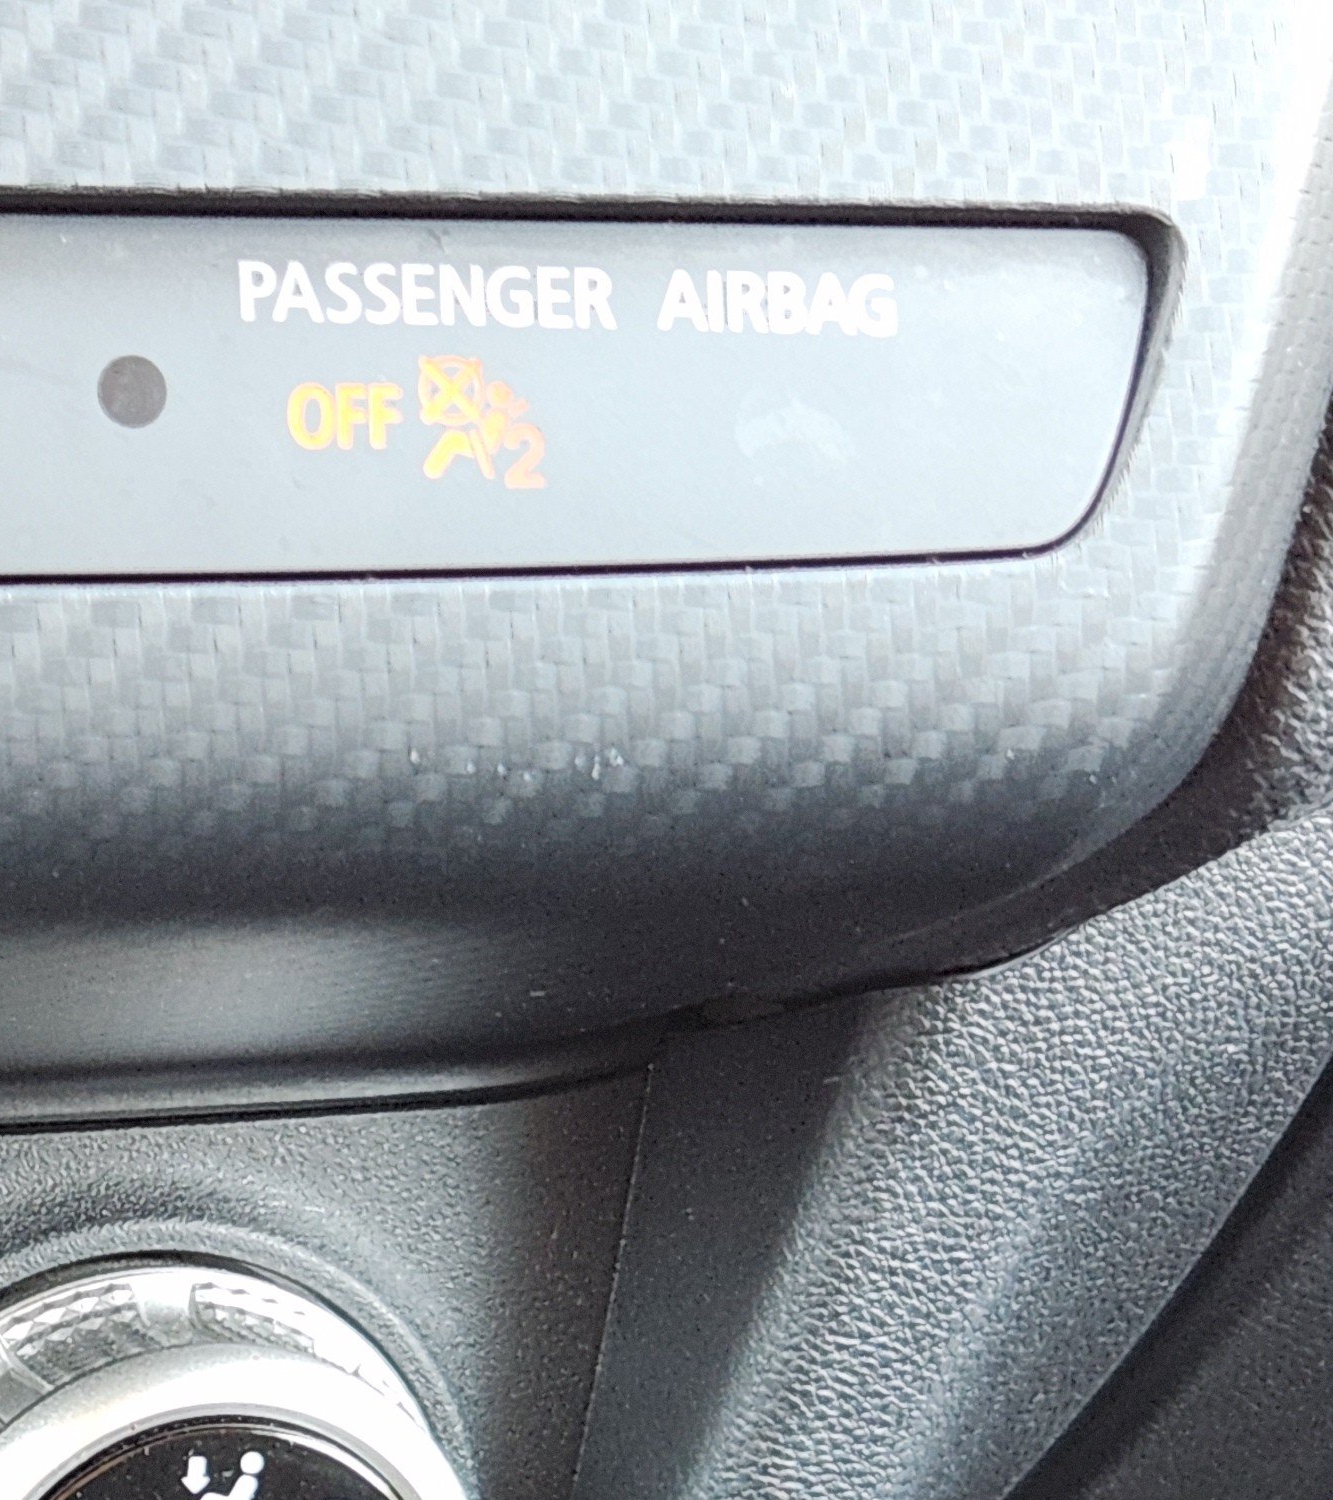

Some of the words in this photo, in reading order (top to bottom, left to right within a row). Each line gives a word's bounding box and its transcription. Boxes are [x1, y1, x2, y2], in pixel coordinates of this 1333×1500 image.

[237, 260, 617, 331] PASSENGER
[657, 269, 899, 338] AIRBAG
[287, 382, 403, 450] OFF
